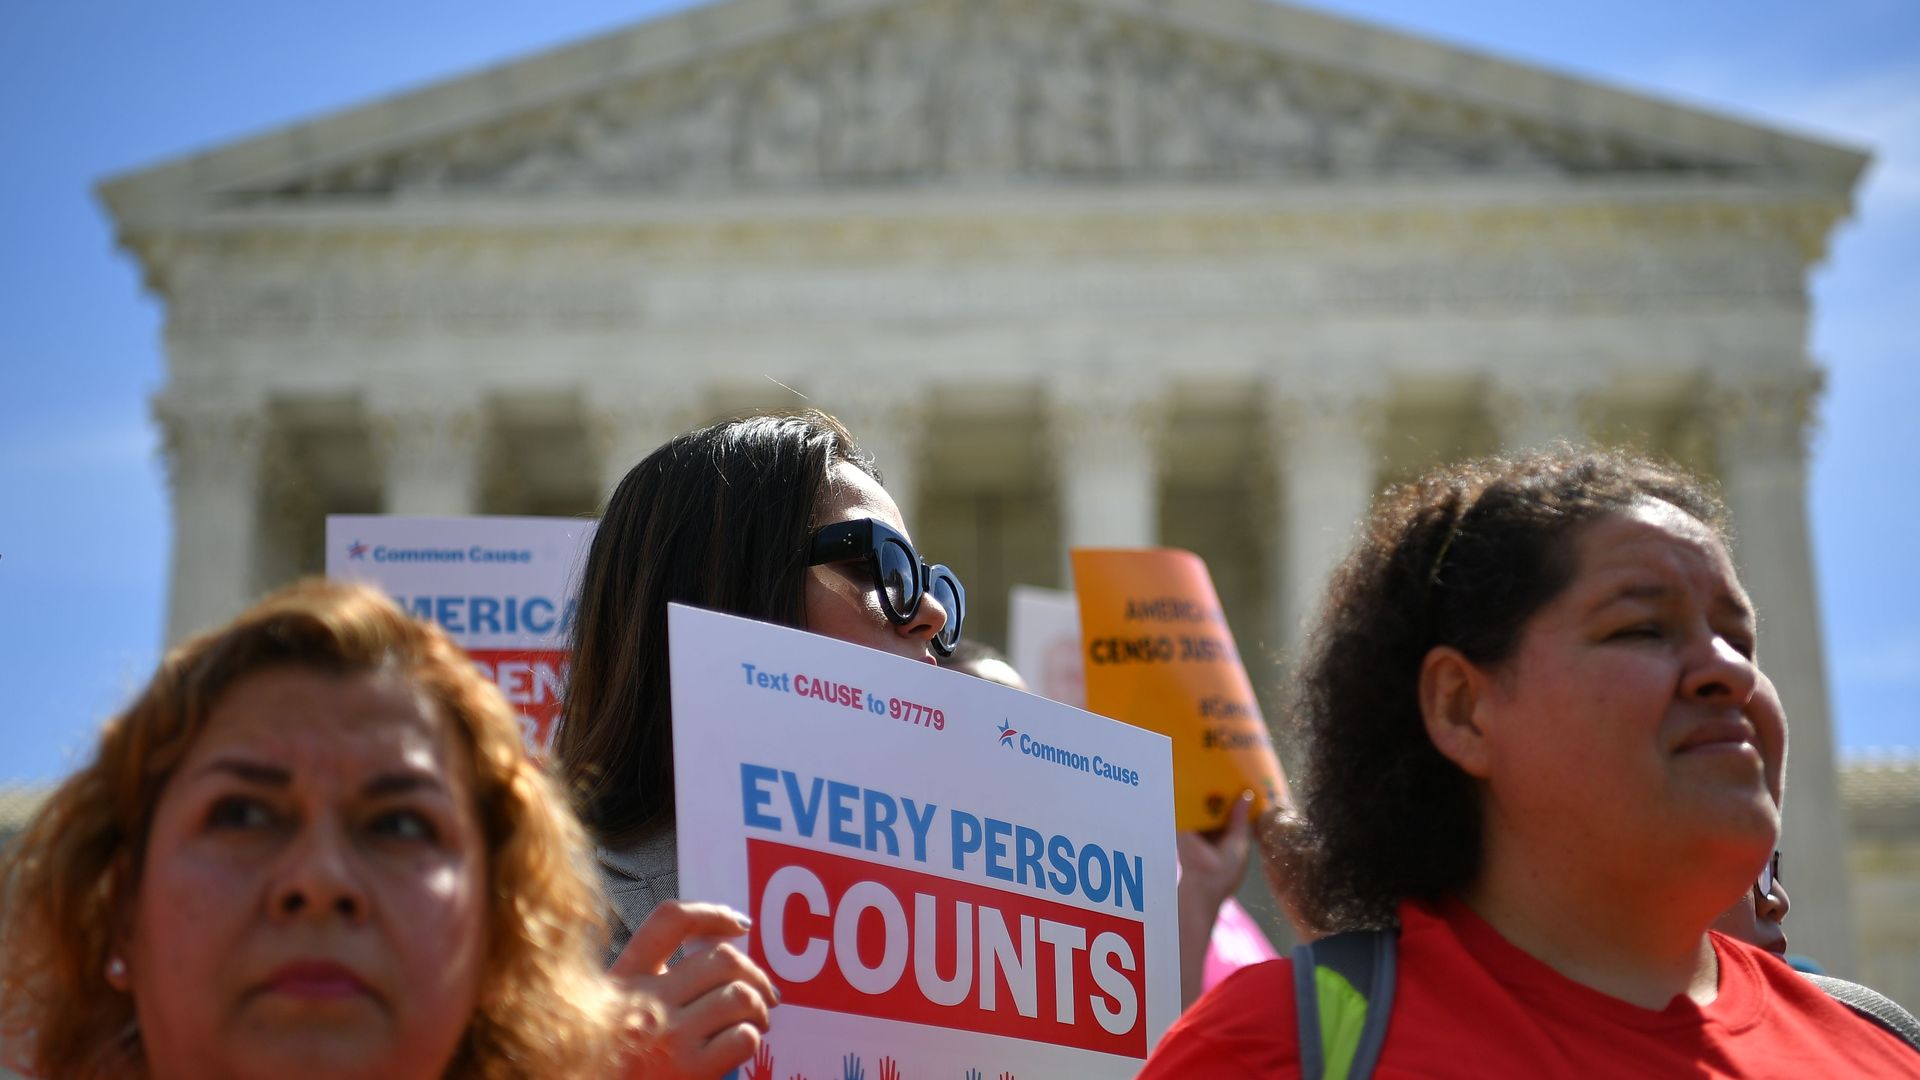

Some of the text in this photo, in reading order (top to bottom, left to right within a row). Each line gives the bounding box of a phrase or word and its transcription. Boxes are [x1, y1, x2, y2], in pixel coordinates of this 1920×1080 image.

[373, 545, 532, 563] Common Cause
[1090, 636, 1173, 664] CENSO
[742, 663, 945, 731] Text CAUSE to 97779
[1020, 733, 1139, 787] Common Cause
[740, 762, 1145, 913] EVERY PERSON
[760, 865, 1138, 1036] COUNTS
